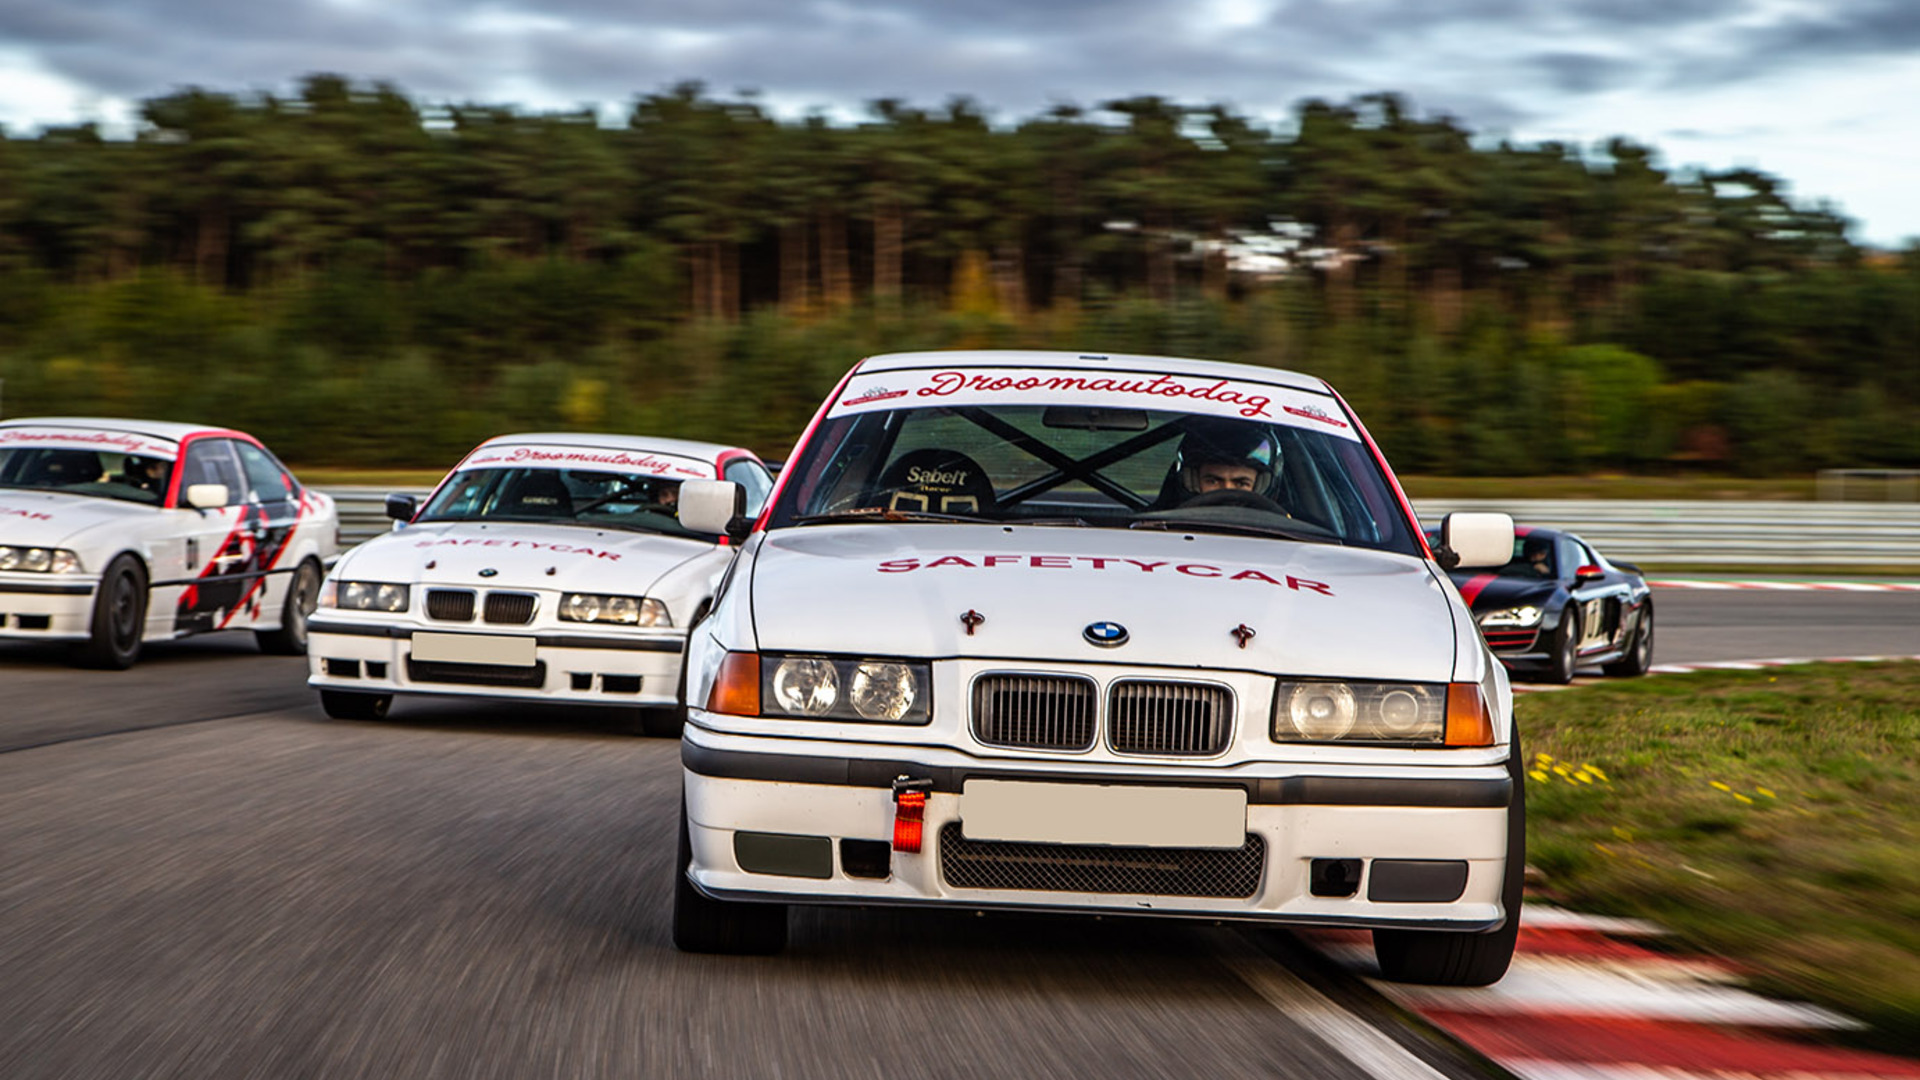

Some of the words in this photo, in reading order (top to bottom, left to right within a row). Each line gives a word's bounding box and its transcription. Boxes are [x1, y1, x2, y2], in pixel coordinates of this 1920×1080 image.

[916, 371, 1272, 418] Droomautodag
[505, 448, 671, 475] Droomautodag
[906, 465, 968, 486] Sabelt
[414, 538, 622, 562] SAFETYCAR
[877, 555, 1335, 597] SAFETYCAR
